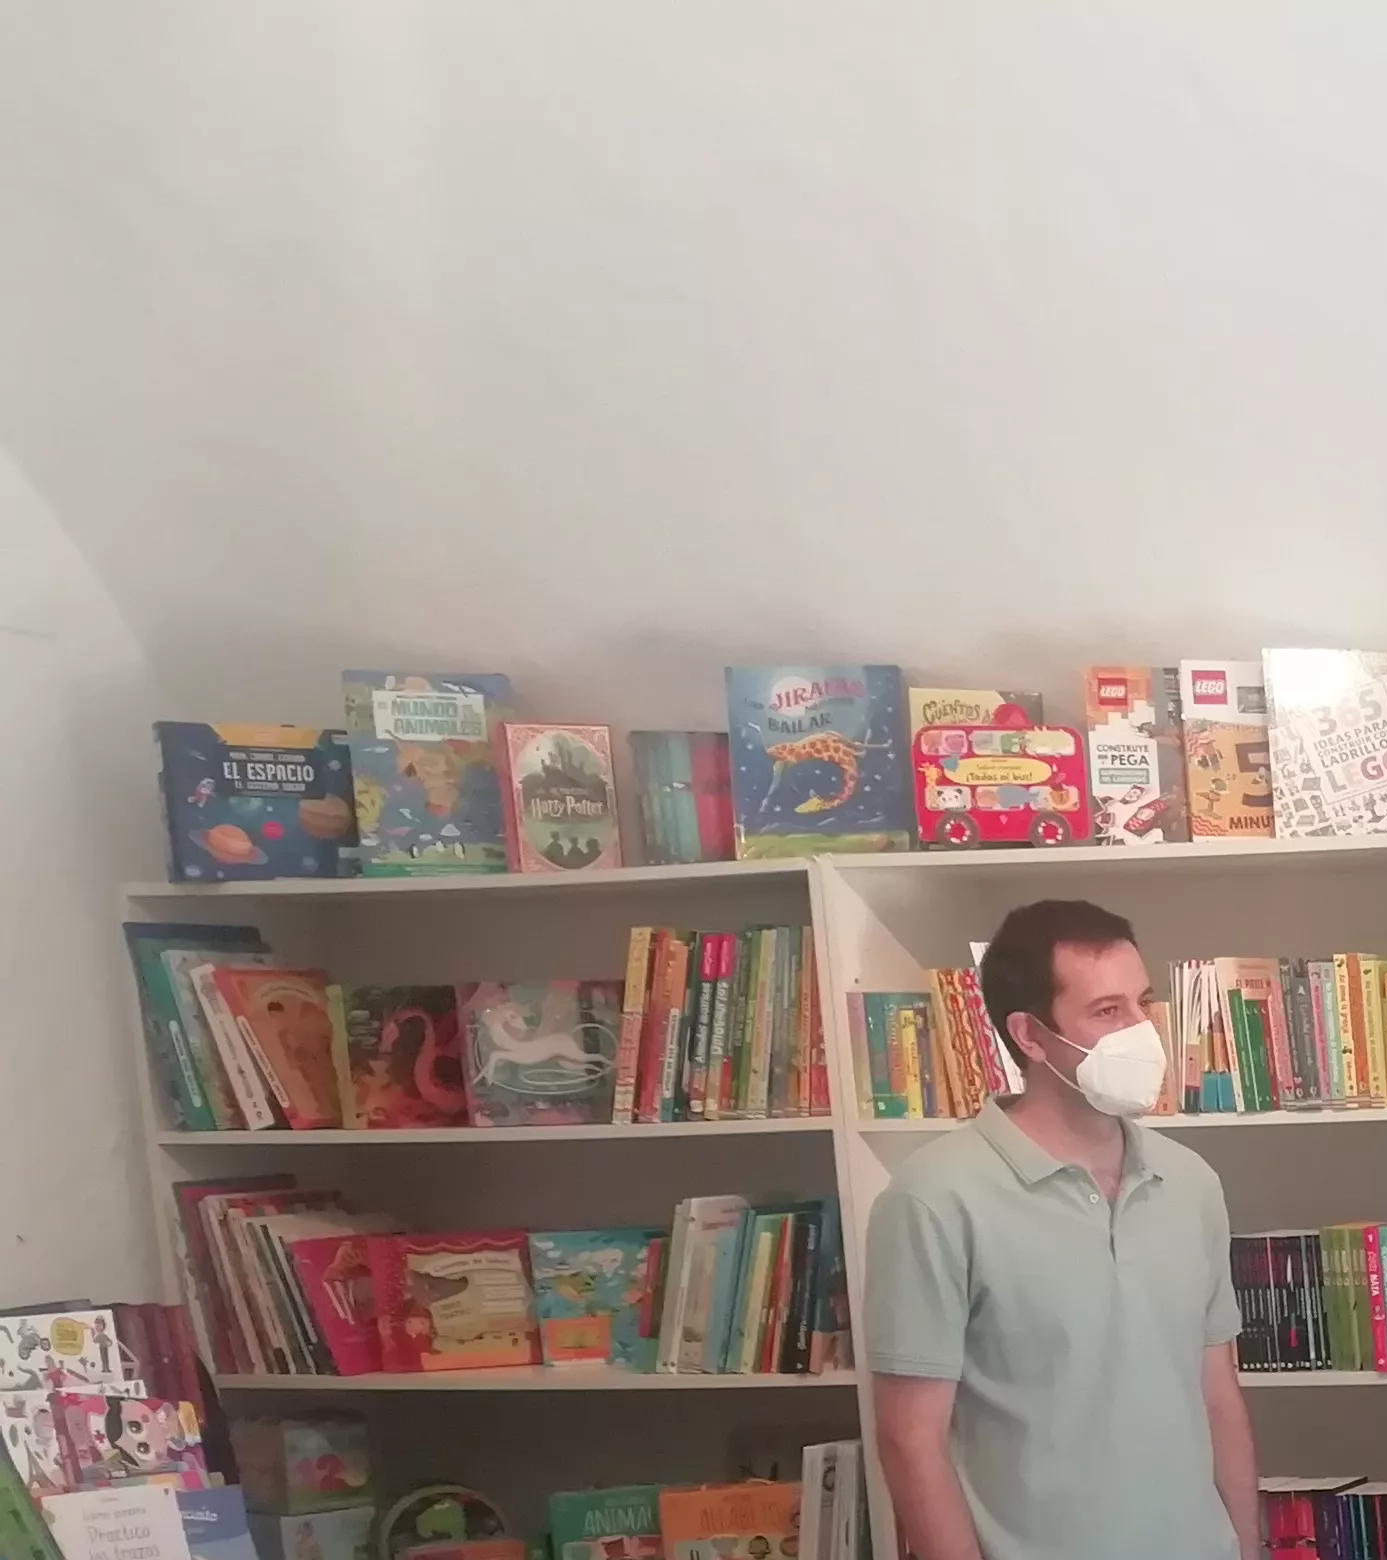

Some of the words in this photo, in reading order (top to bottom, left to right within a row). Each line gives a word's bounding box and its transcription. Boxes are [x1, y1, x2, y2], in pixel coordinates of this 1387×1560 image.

[1100, 685, 1126, 699] LEGO
[1195, 679, 1224, 694] LEGO
[1110, 753, 1150, 767] PEGA
[223, 761, 241, 780] EL
[246, 762, 315, 782] ESPACIO
[530, 795, 566, 820] Harry
